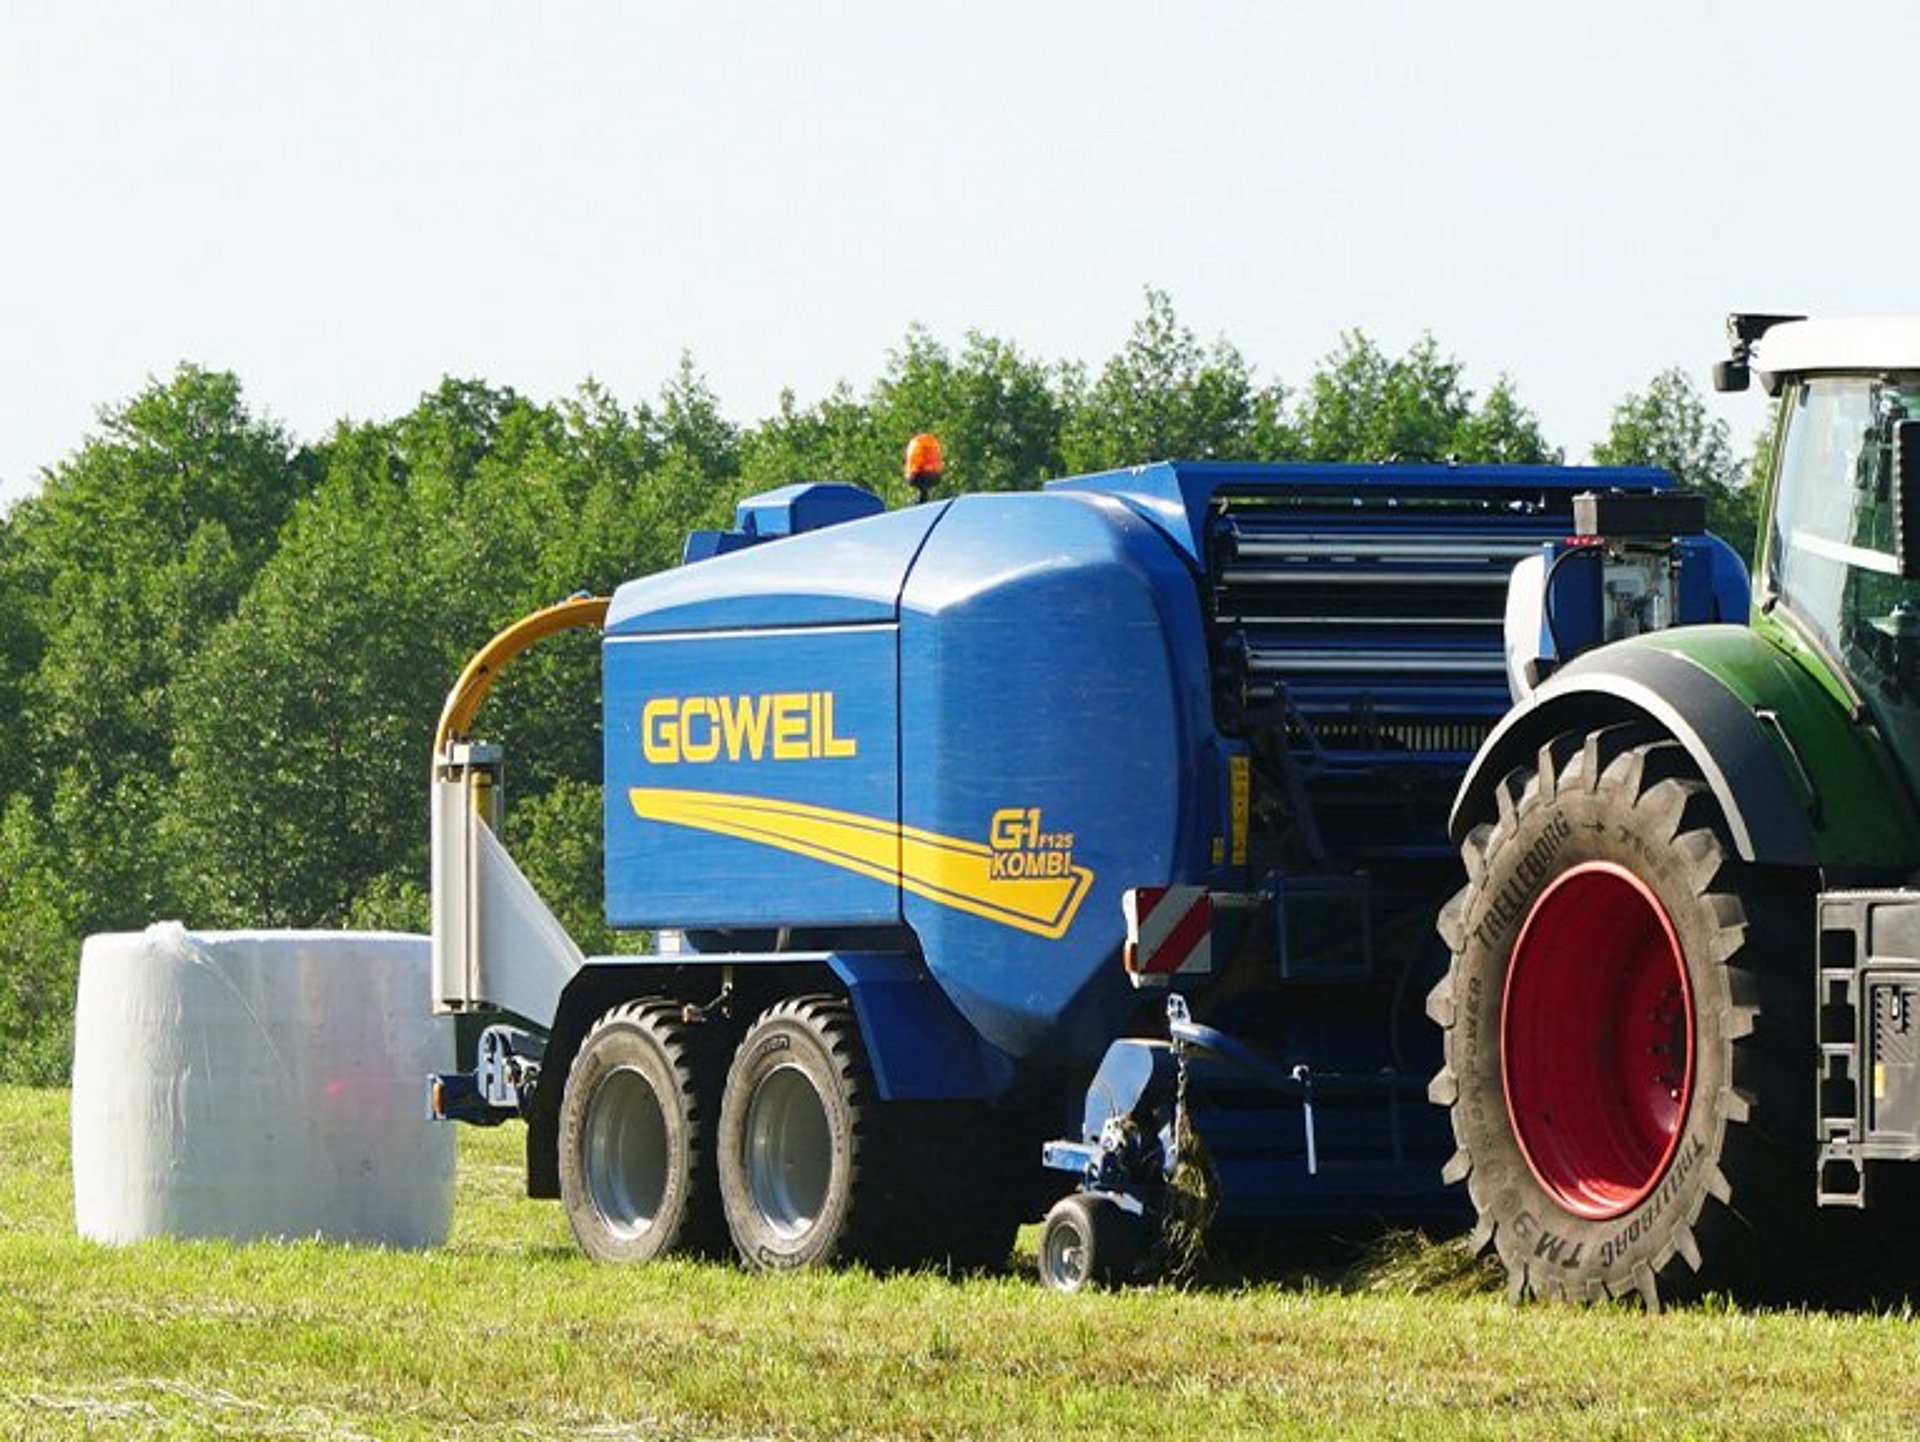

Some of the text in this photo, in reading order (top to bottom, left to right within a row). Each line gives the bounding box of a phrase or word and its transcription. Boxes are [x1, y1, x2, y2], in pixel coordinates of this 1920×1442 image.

[991, 850, 1072, 877] KOMBI
[1473, 809, 1573, 951] TRELLEBORG
[1600, 1134, 1705, 1269] TRELLEBORG
